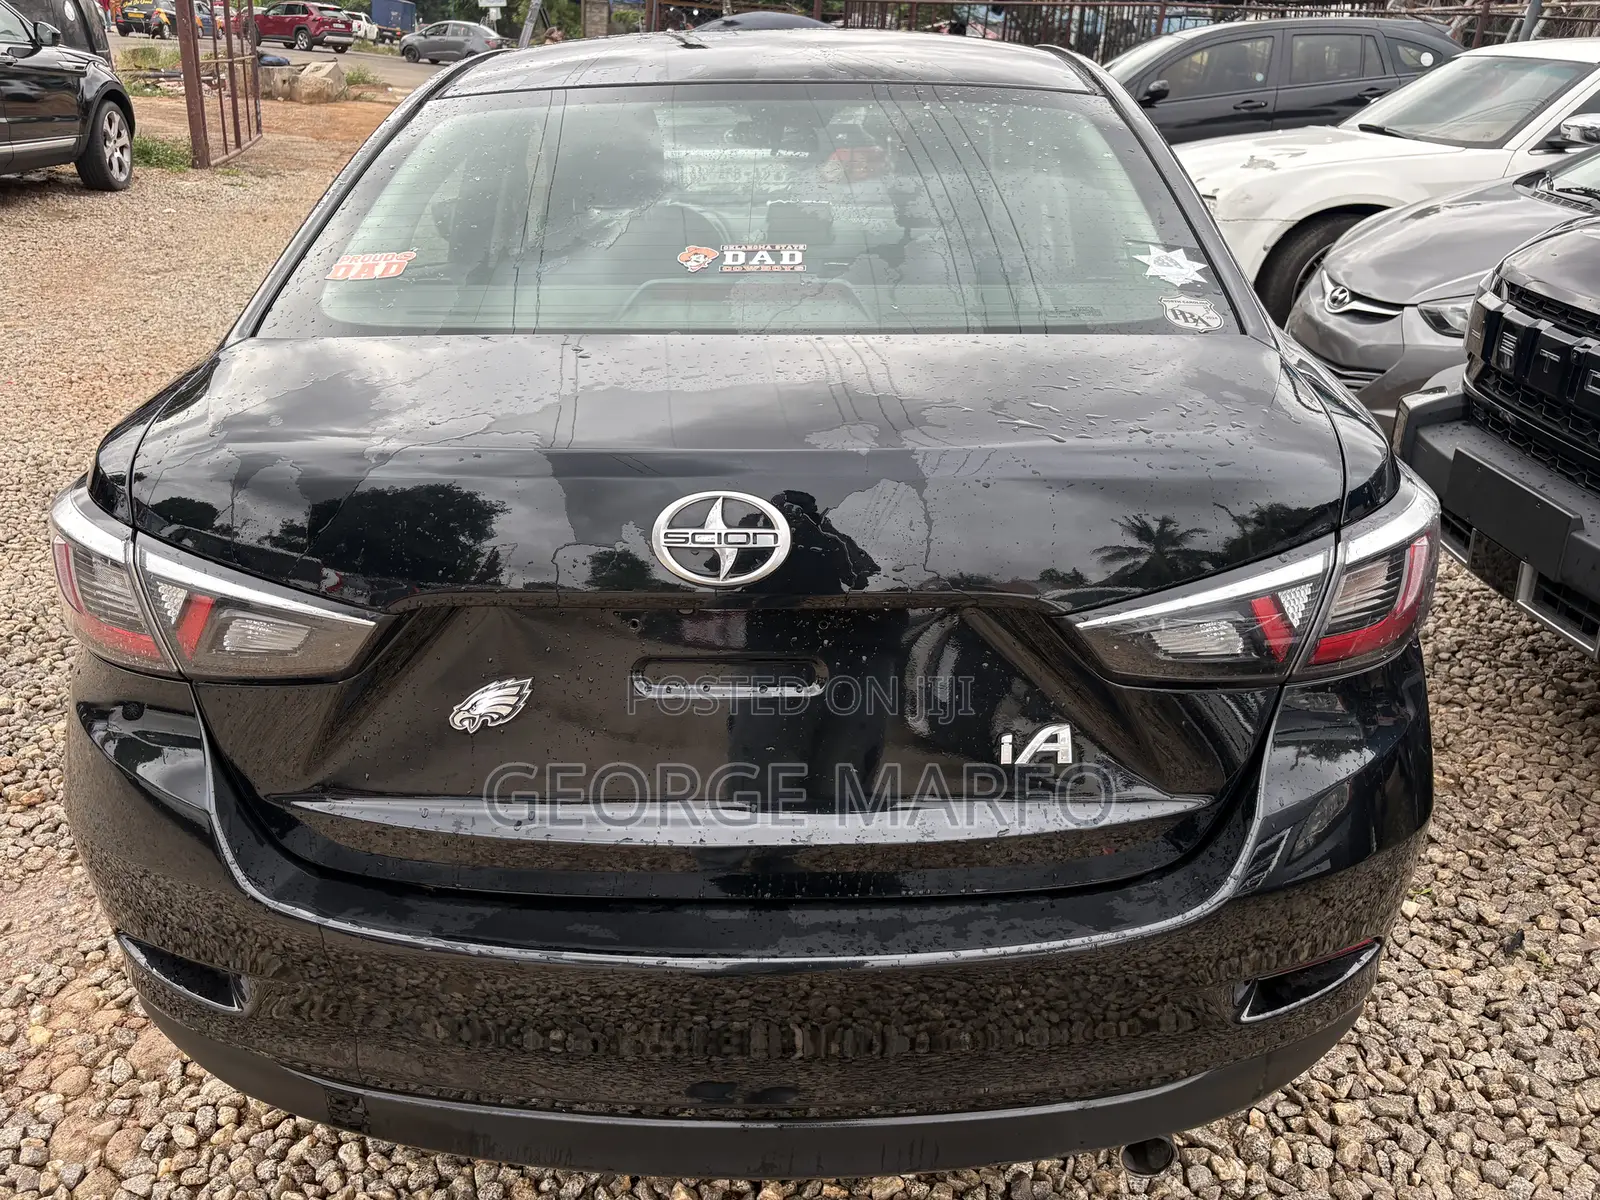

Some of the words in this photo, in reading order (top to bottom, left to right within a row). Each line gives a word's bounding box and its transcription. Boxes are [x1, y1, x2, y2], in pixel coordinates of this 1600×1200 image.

[338, 252, 397, 264] PROUD
[722, 250, 804, 266] DAD
[329, 261, 407, 279] DAD
[1168, 308, 1212, 327] PBA
[1000, 723, 1073, 765] iA
